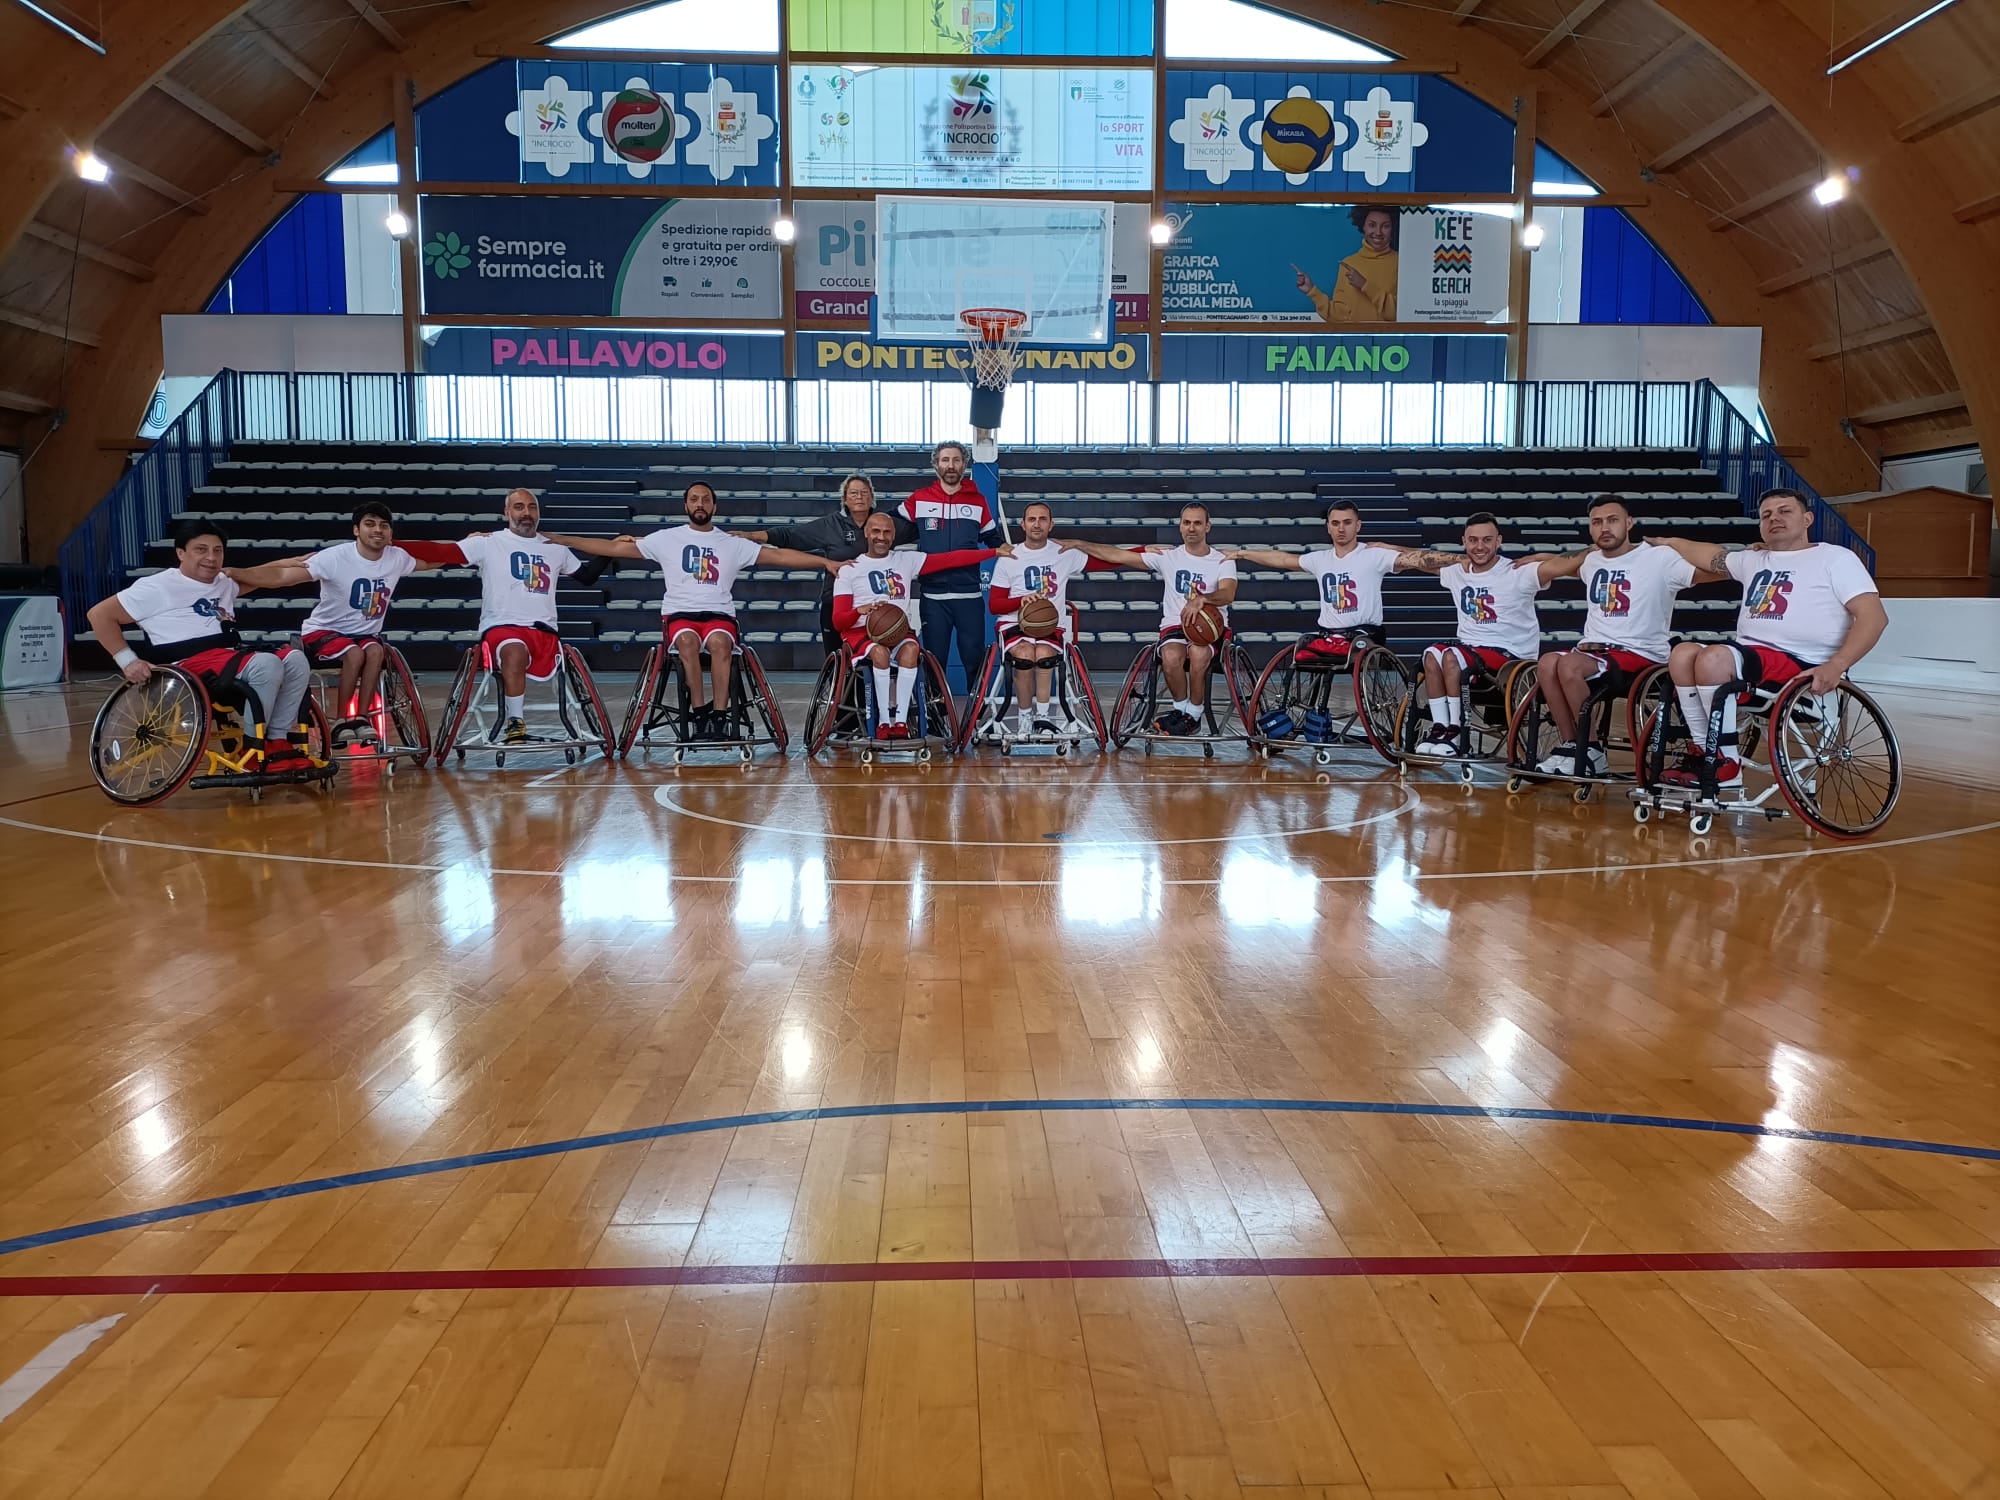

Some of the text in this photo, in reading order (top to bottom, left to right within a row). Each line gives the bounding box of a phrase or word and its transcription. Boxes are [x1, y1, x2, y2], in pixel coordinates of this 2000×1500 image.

[621, 121, 656, 130] molten
[1112, 123, 1144, 132] SPORT
[1115, 144, 1144, 156] VITA
[661, 224, 772, 238] Spedizione rapida
[477, 235, 566, 260] Sempre
[662, 241, 782, 253] e gratuita per ordin
[662, 256, 690, 266] oltre
[700, 257, 738, 268] 29,90€
[1163, 255, 1219, 267] GRAFICA
[477, 259, 605, 279] farmacia.it
[1162, 269, 1214, 281] STAMPA
[820, 277, 871, 287] COCCOLE
[1162, 280, 1239, 295] PUBBLICITÀ
[1432, 277, 1471, 294] BEACH
[1115, 301, 1137, 317] ZI!
[1162, 297, 1254, 309] SOCIAL MEDIA
[492, 338, 727, 369] PALLAVOLO
[1266, 345, 1410, 372] FAIANO
